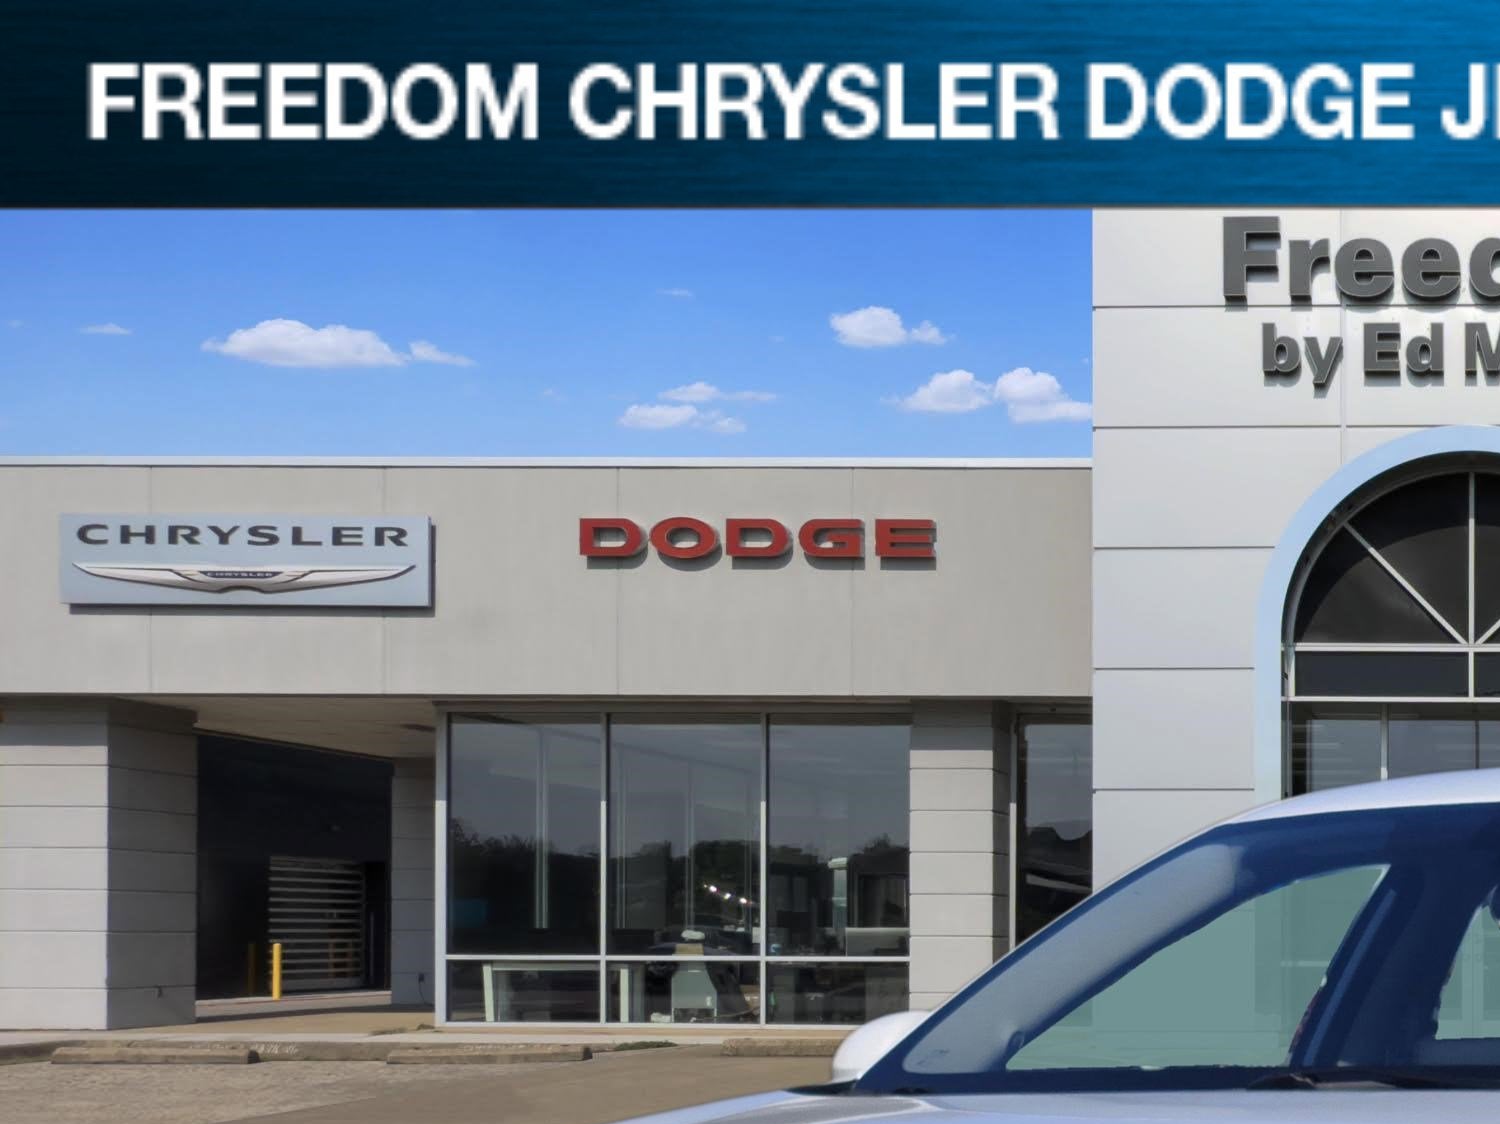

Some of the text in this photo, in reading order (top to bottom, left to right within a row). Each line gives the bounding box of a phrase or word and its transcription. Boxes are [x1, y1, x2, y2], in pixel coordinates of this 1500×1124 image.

[1262, 322, 1344, 387] by
[1363, 322, 1445, 378] Ed
[76, 523, 408, 547] CHRYSLER
[579, 516, 937, 559] DODGE
